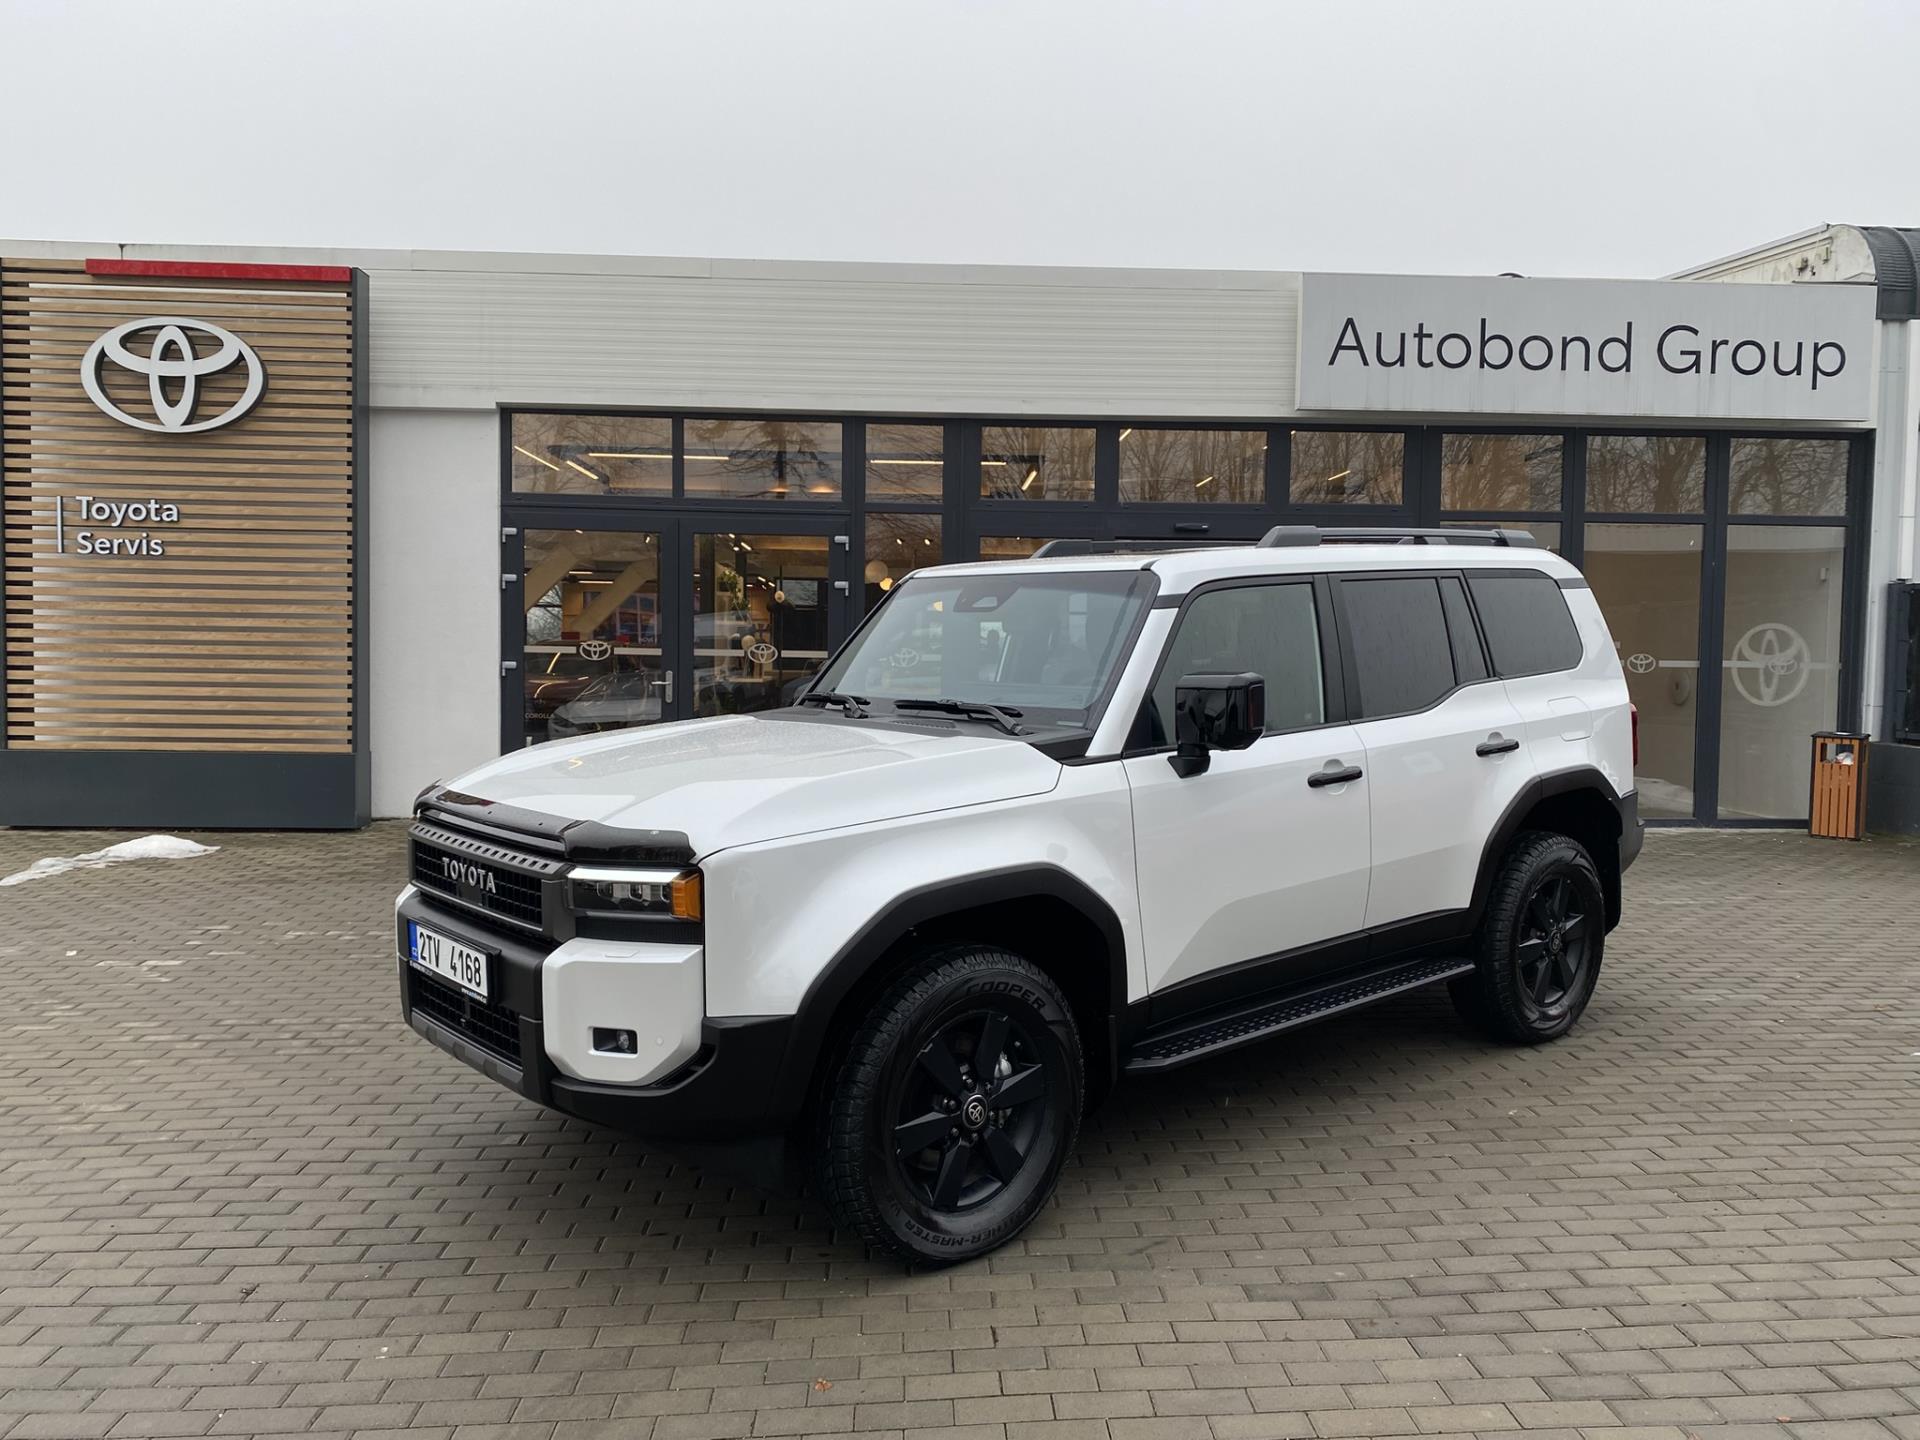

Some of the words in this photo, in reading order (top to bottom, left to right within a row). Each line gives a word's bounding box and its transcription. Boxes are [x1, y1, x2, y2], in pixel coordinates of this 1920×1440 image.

[1328, 316, 1633, 374] Autobond
[1656, 324, 1846, 390] Group
[75, 495, 180, 527] Toyota
[76, 531, 165, 556] Servis
[441, 856, 497, 894] TOYOTA
[419, 931, 441, 968] 2TV
[449, 945, 482, 988] 4168
[967, 981, 1046, 1010] COOPER
